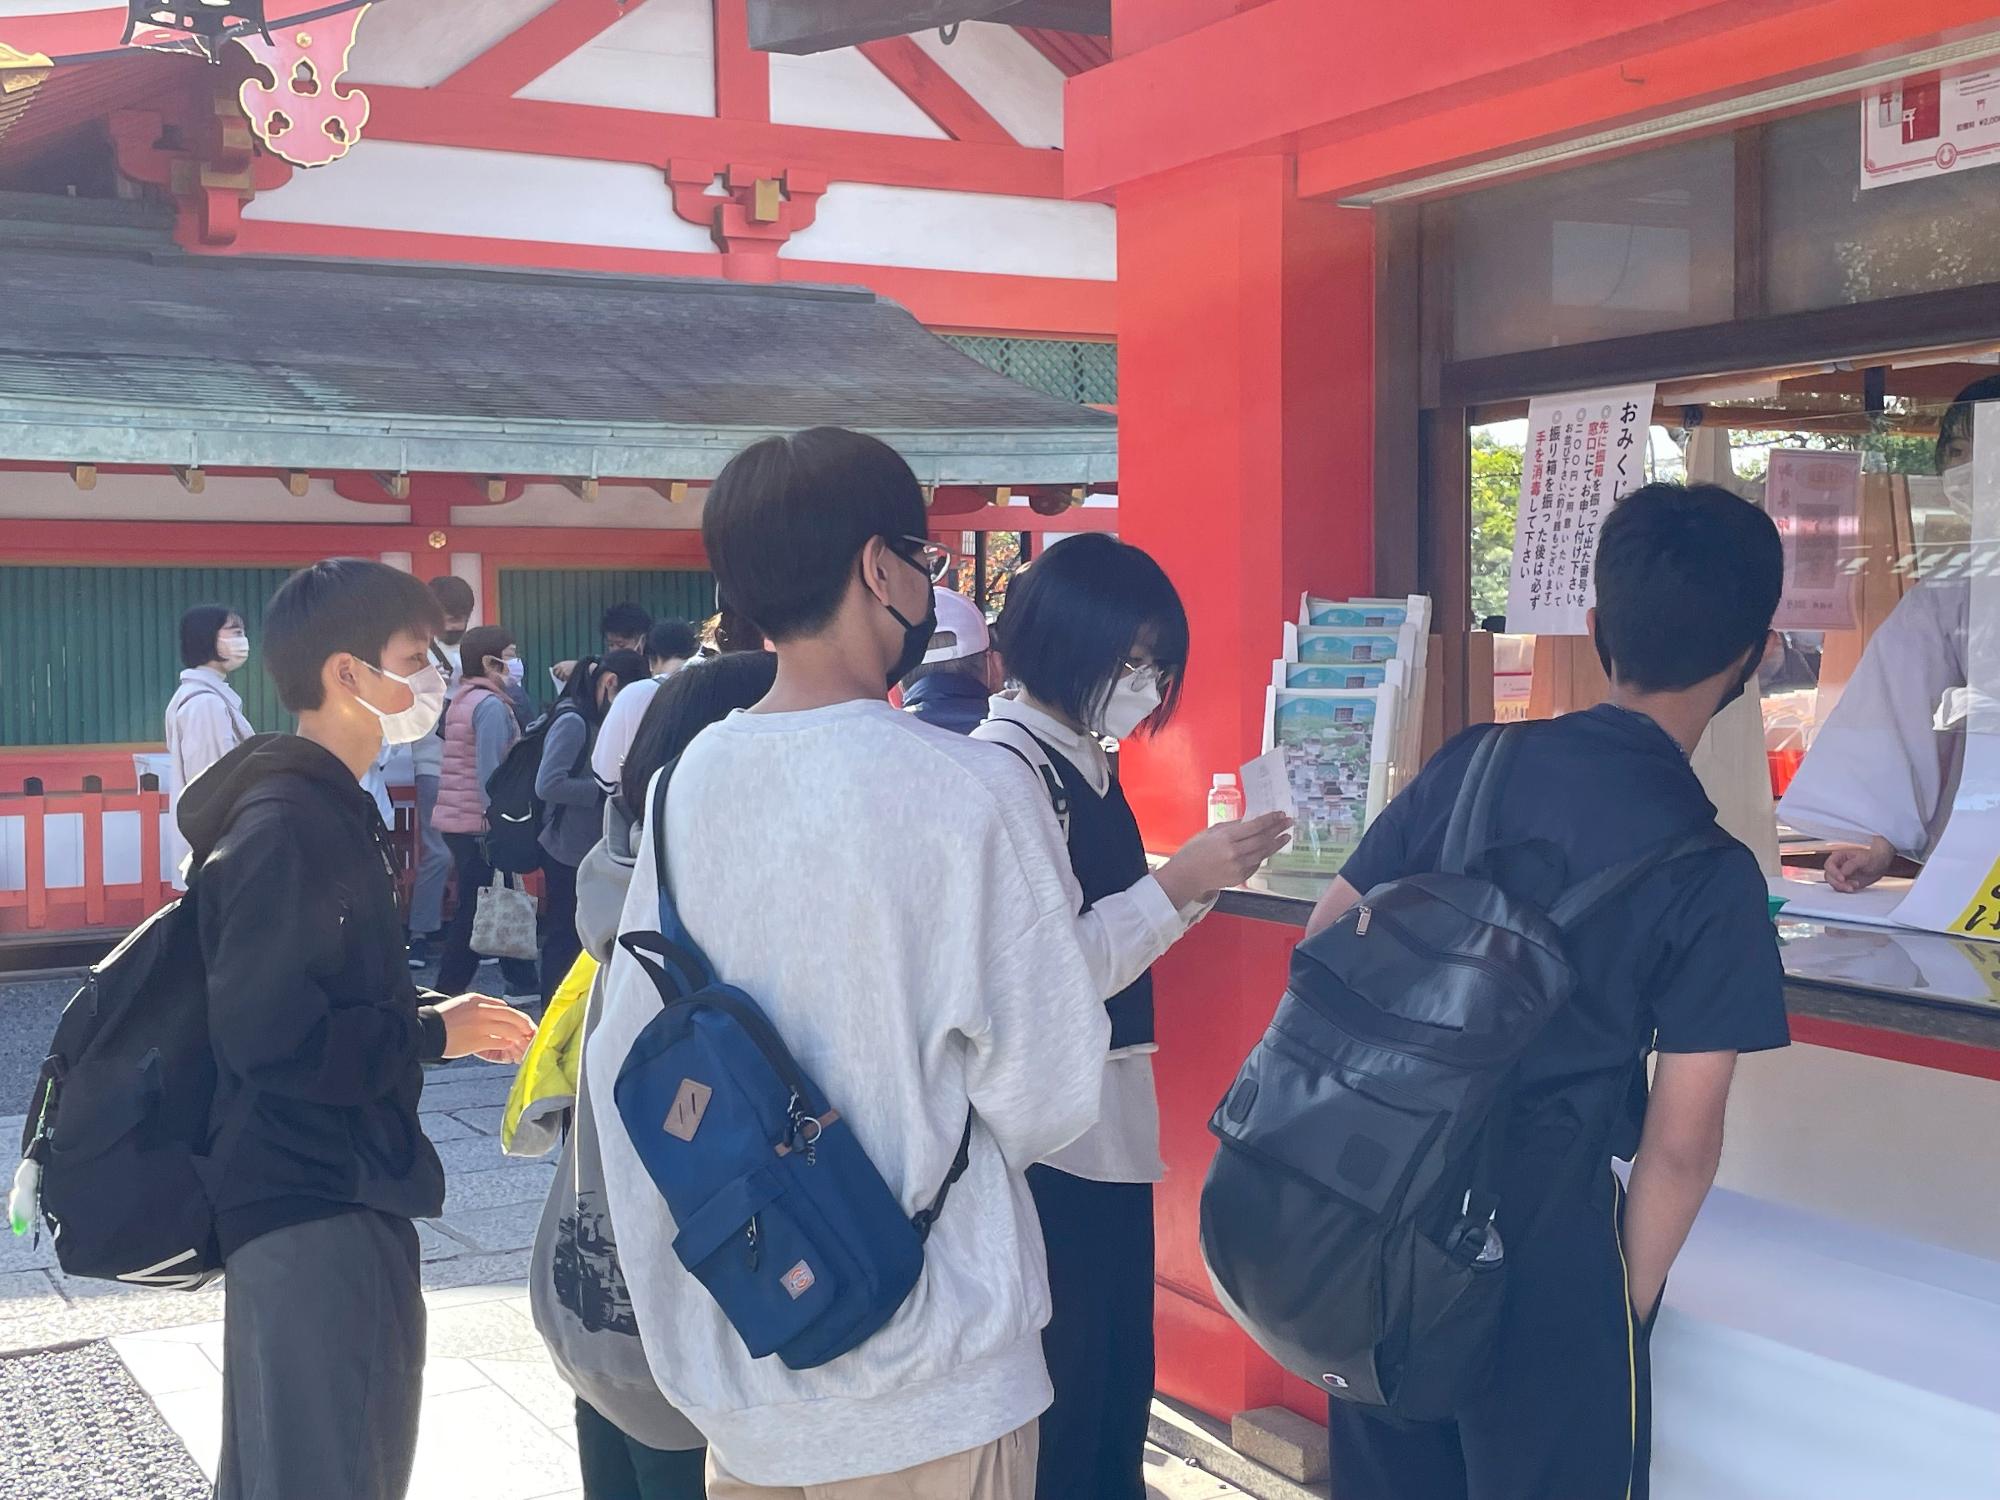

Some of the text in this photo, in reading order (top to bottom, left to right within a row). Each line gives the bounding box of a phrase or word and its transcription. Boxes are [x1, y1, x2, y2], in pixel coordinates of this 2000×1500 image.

[1520, 430, 1546, 578] 手を消毒して下さい
[1529, 425, 1561, 610] 振り箱を振った後は必ず
[1567, 421, 1598, 605] 窓口にてお申し付け下さい
[1613, 401, 1638, 502] おみくじ
